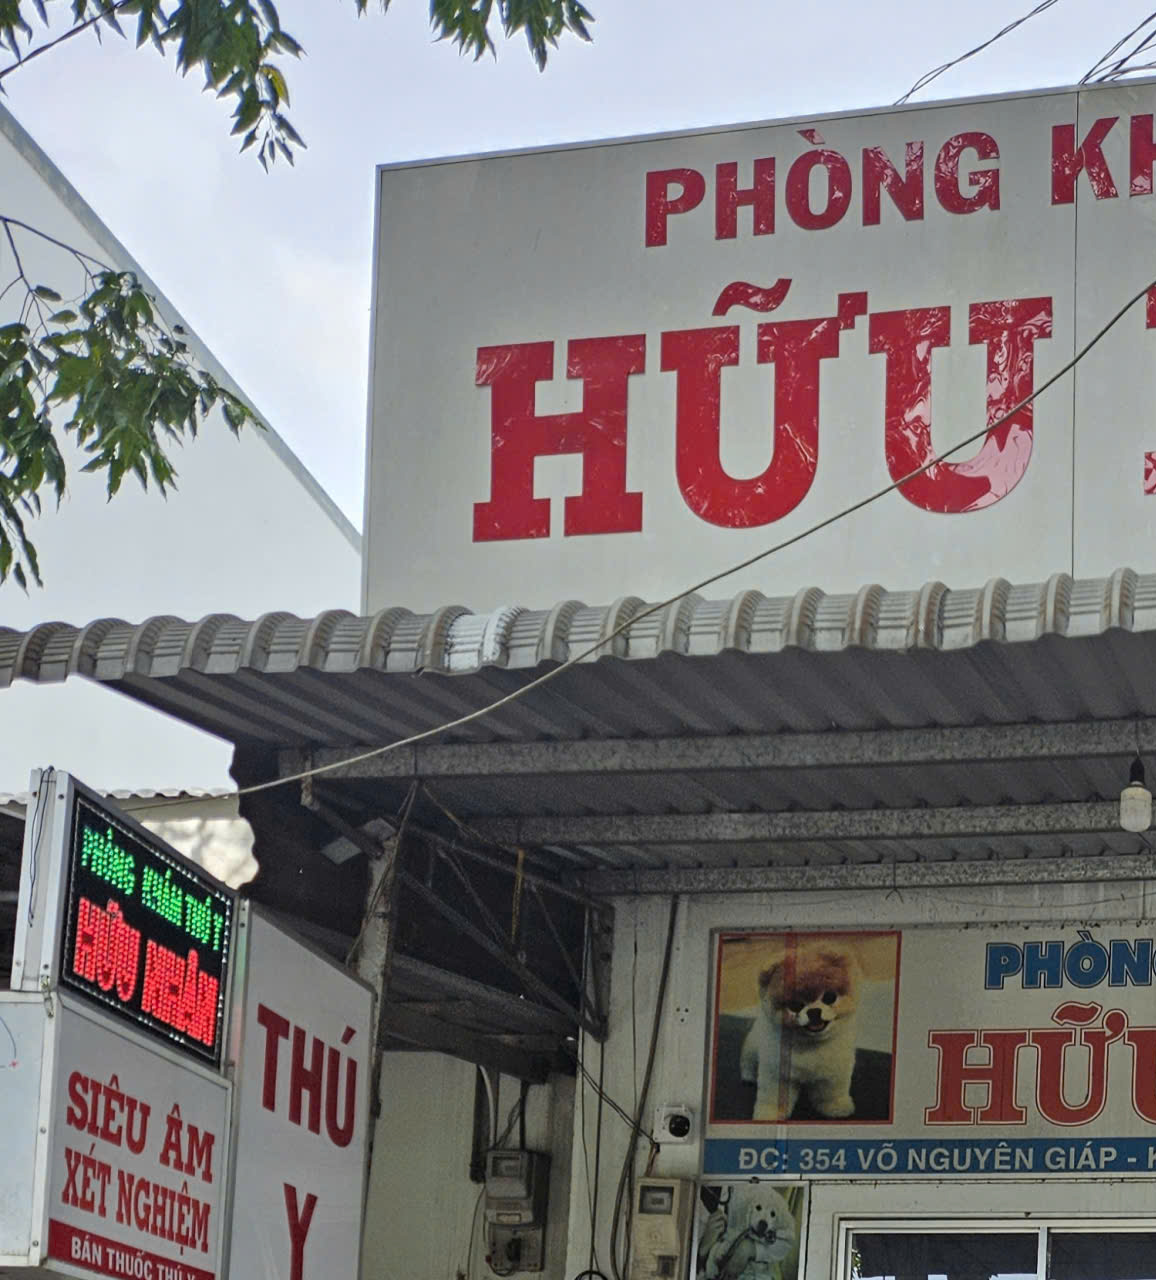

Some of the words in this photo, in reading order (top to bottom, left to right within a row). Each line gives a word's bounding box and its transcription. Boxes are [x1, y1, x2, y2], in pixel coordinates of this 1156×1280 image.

[645, 129, 1001, 247] PHÒNG
[473, 278, 1053, 542] HỮU
[66, 1071, 152, 1155] SIÊU
[159, 1103, 216, 1184] ÂM
[257, 1003, 358, 1148] THÚ
[62, 1142, 112, 1218] XÉT
[116, 1170, 211, 1256] NGHIỆM
[799, 1148, 847, 1171] 354
[858, 1143, 898, 1171] VÕ
[908, 1142, 1039, 1170] NGUYÊN
[1044, 1141, 1116, 1170] GIÁP
[71, 1234, 102, 1266] BÁN
[106, 1247, 153, 1280] THUỐC
